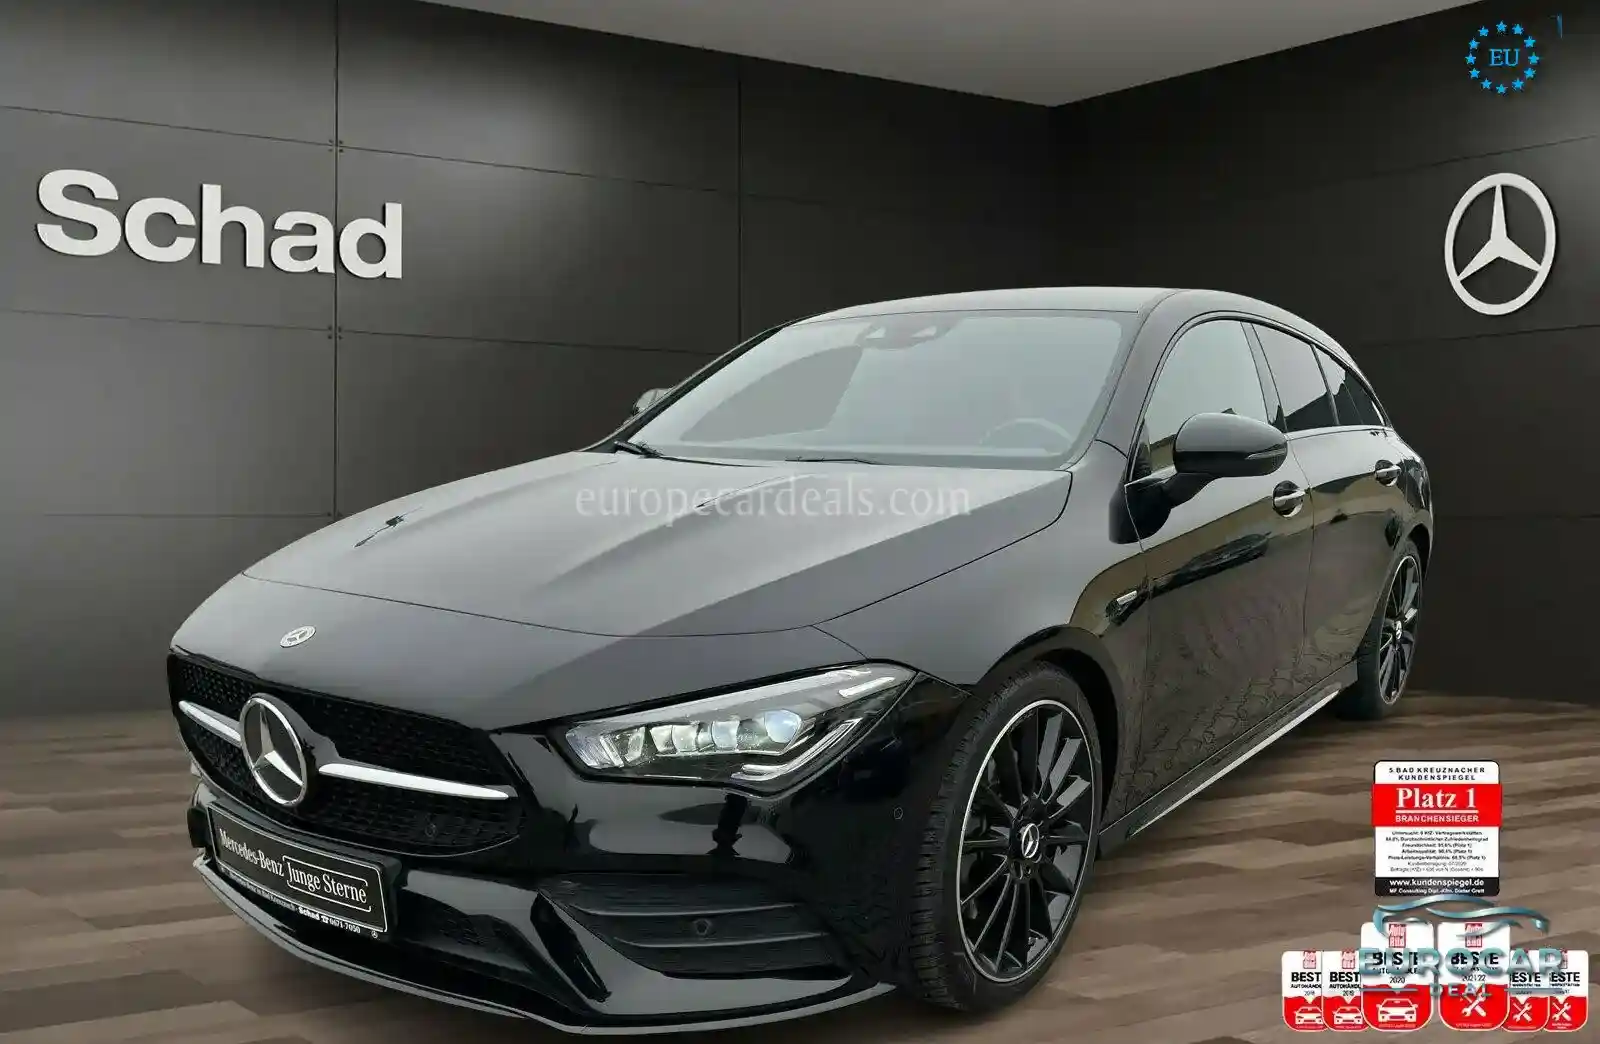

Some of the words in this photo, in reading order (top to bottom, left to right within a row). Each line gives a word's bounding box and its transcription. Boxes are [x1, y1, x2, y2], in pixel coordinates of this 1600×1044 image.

[36, 169, 403, 279] Schad
[219, 828, 286, 877] Mercedes-Benz
[287, 861, 321, 893] Junge
[322, 873, 367, 904] Sterne
